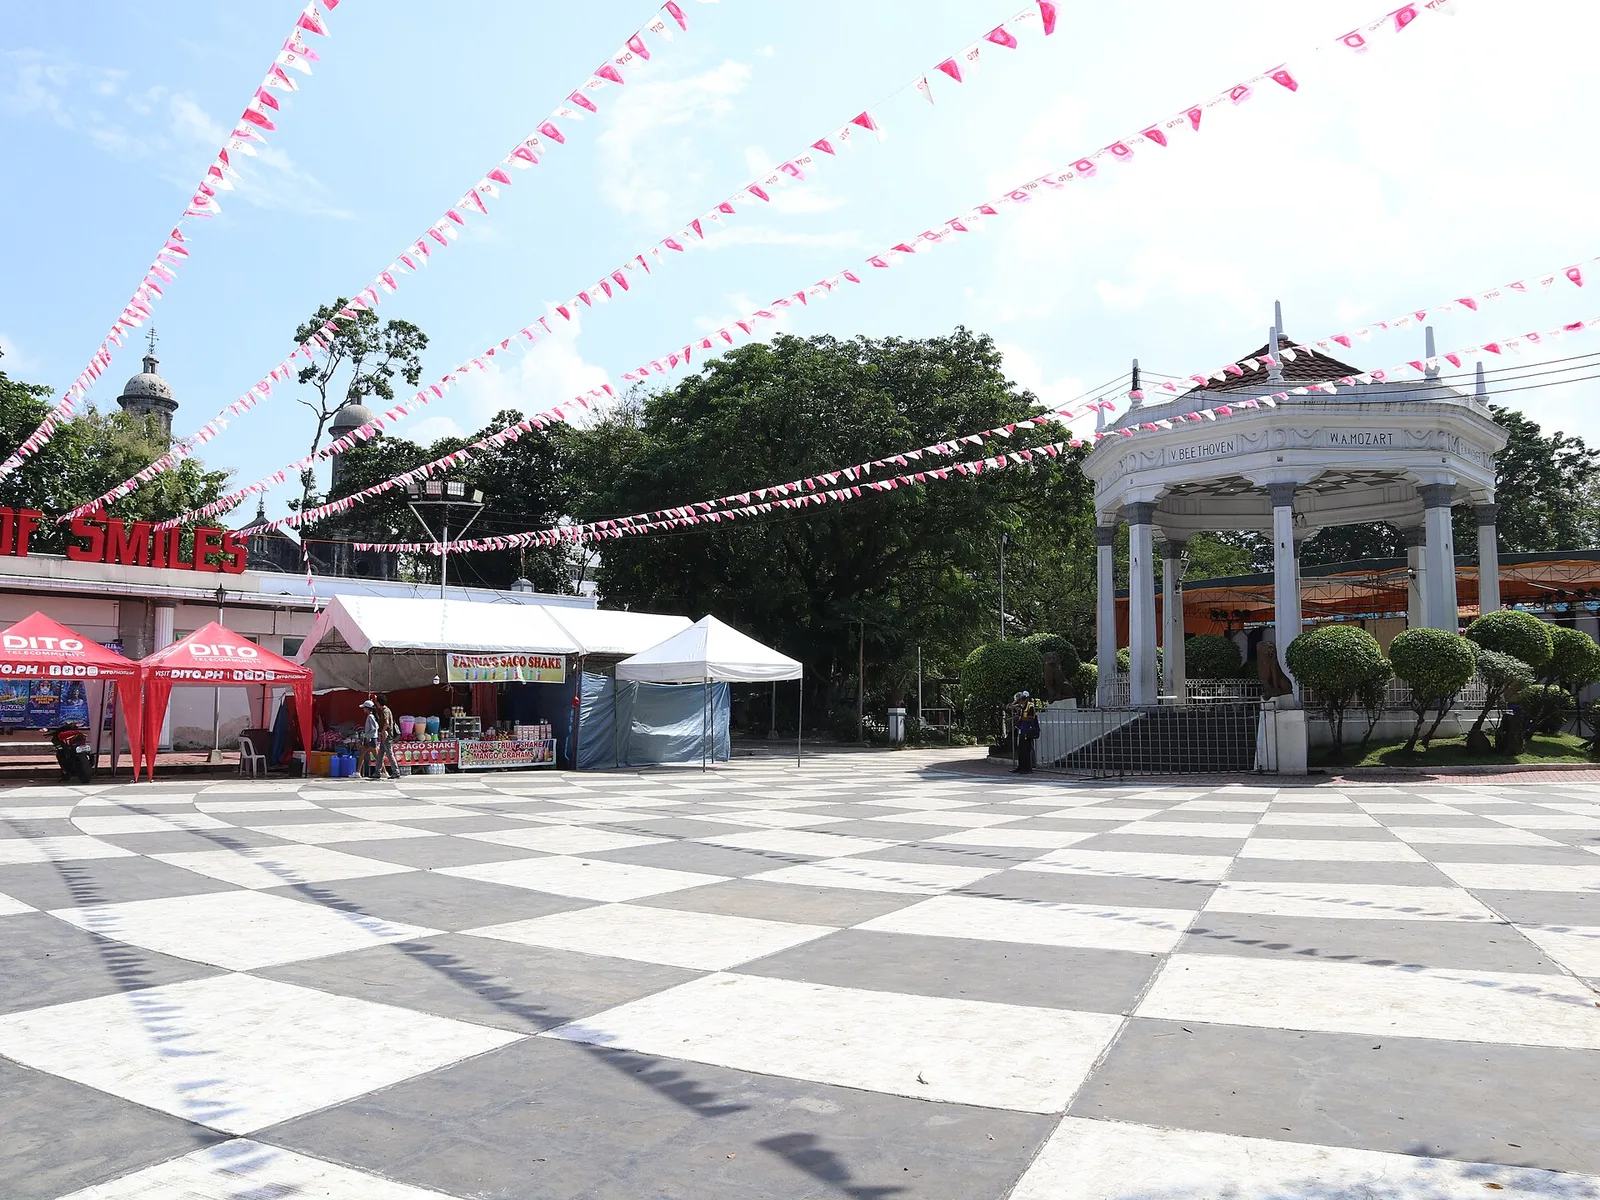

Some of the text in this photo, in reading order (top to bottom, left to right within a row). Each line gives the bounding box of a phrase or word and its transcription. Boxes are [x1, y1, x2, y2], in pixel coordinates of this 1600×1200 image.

[66, 504, 249, 575] SMILES
[3, 634, 84, 651] DITO
[188, 643, 258, 658] DITO
[452, 655, 562, 669] YANNA'S SAGO SHAKE
[0, 664, 39, 675] O.PH
[171, 669, 224, 680] DITO.PH
[401, 743, 426, 751] SAGO
[427, 742, 456, 750] SHAKE
[497, 742, 517, 750] FRUIT
[520, 741, 544, 749] SHAKE
[472, 750, 535, 759] MANGO GRAHAMS
